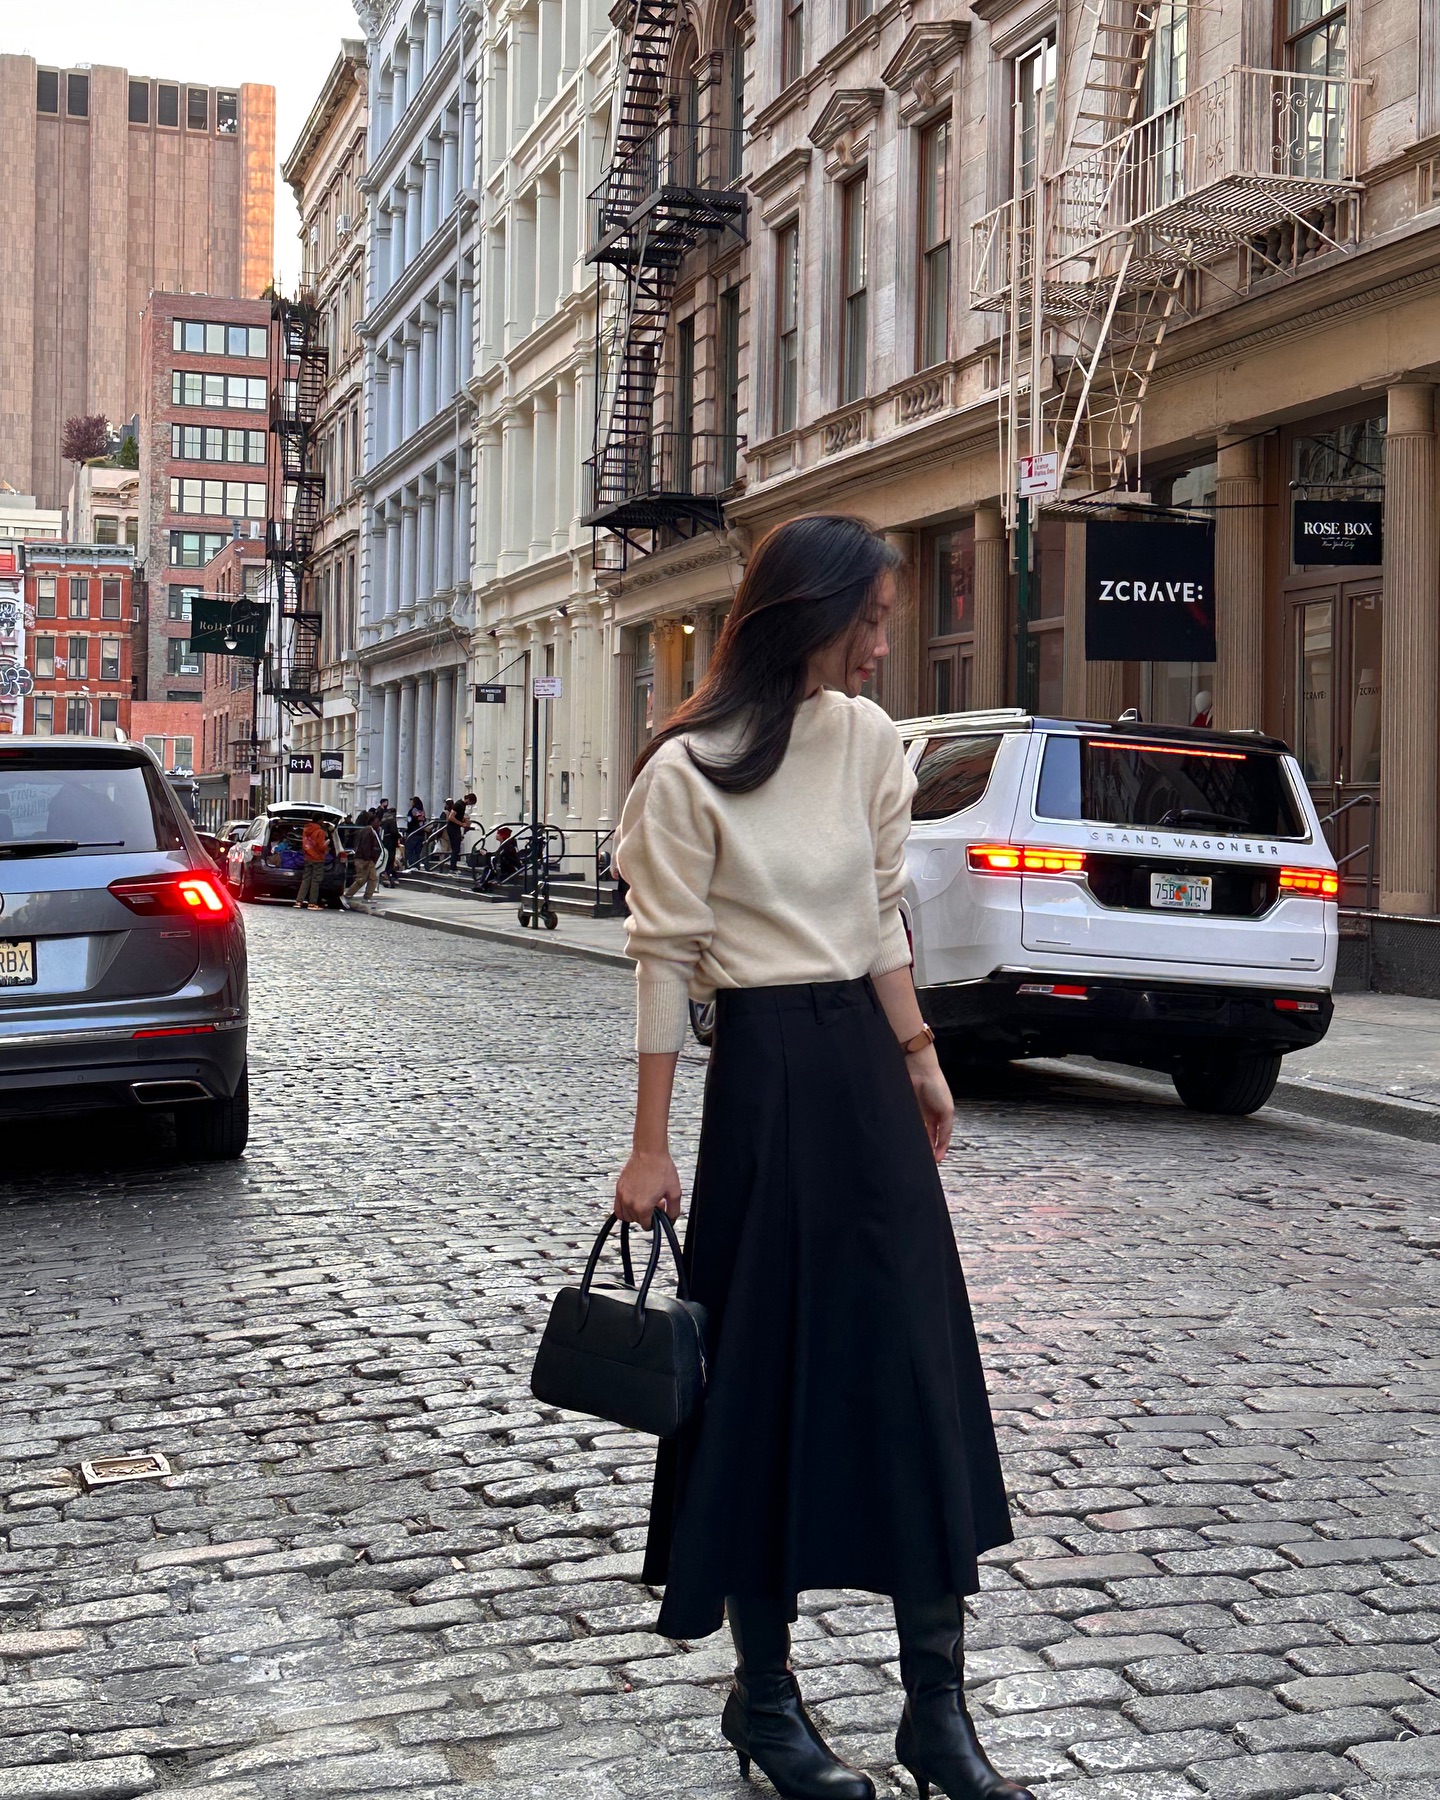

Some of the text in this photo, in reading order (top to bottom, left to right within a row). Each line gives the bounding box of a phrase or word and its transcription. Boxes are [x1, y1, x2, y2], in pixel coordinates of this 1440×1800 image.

[1303, 521, 1374, 536] ROSE BOX
[1098, 580, 1204, 602] ZCRAVE:
[1090, 831, 1279, 856] GRAND WAGONEER
[1188, 885, 1209, 901] TQY
